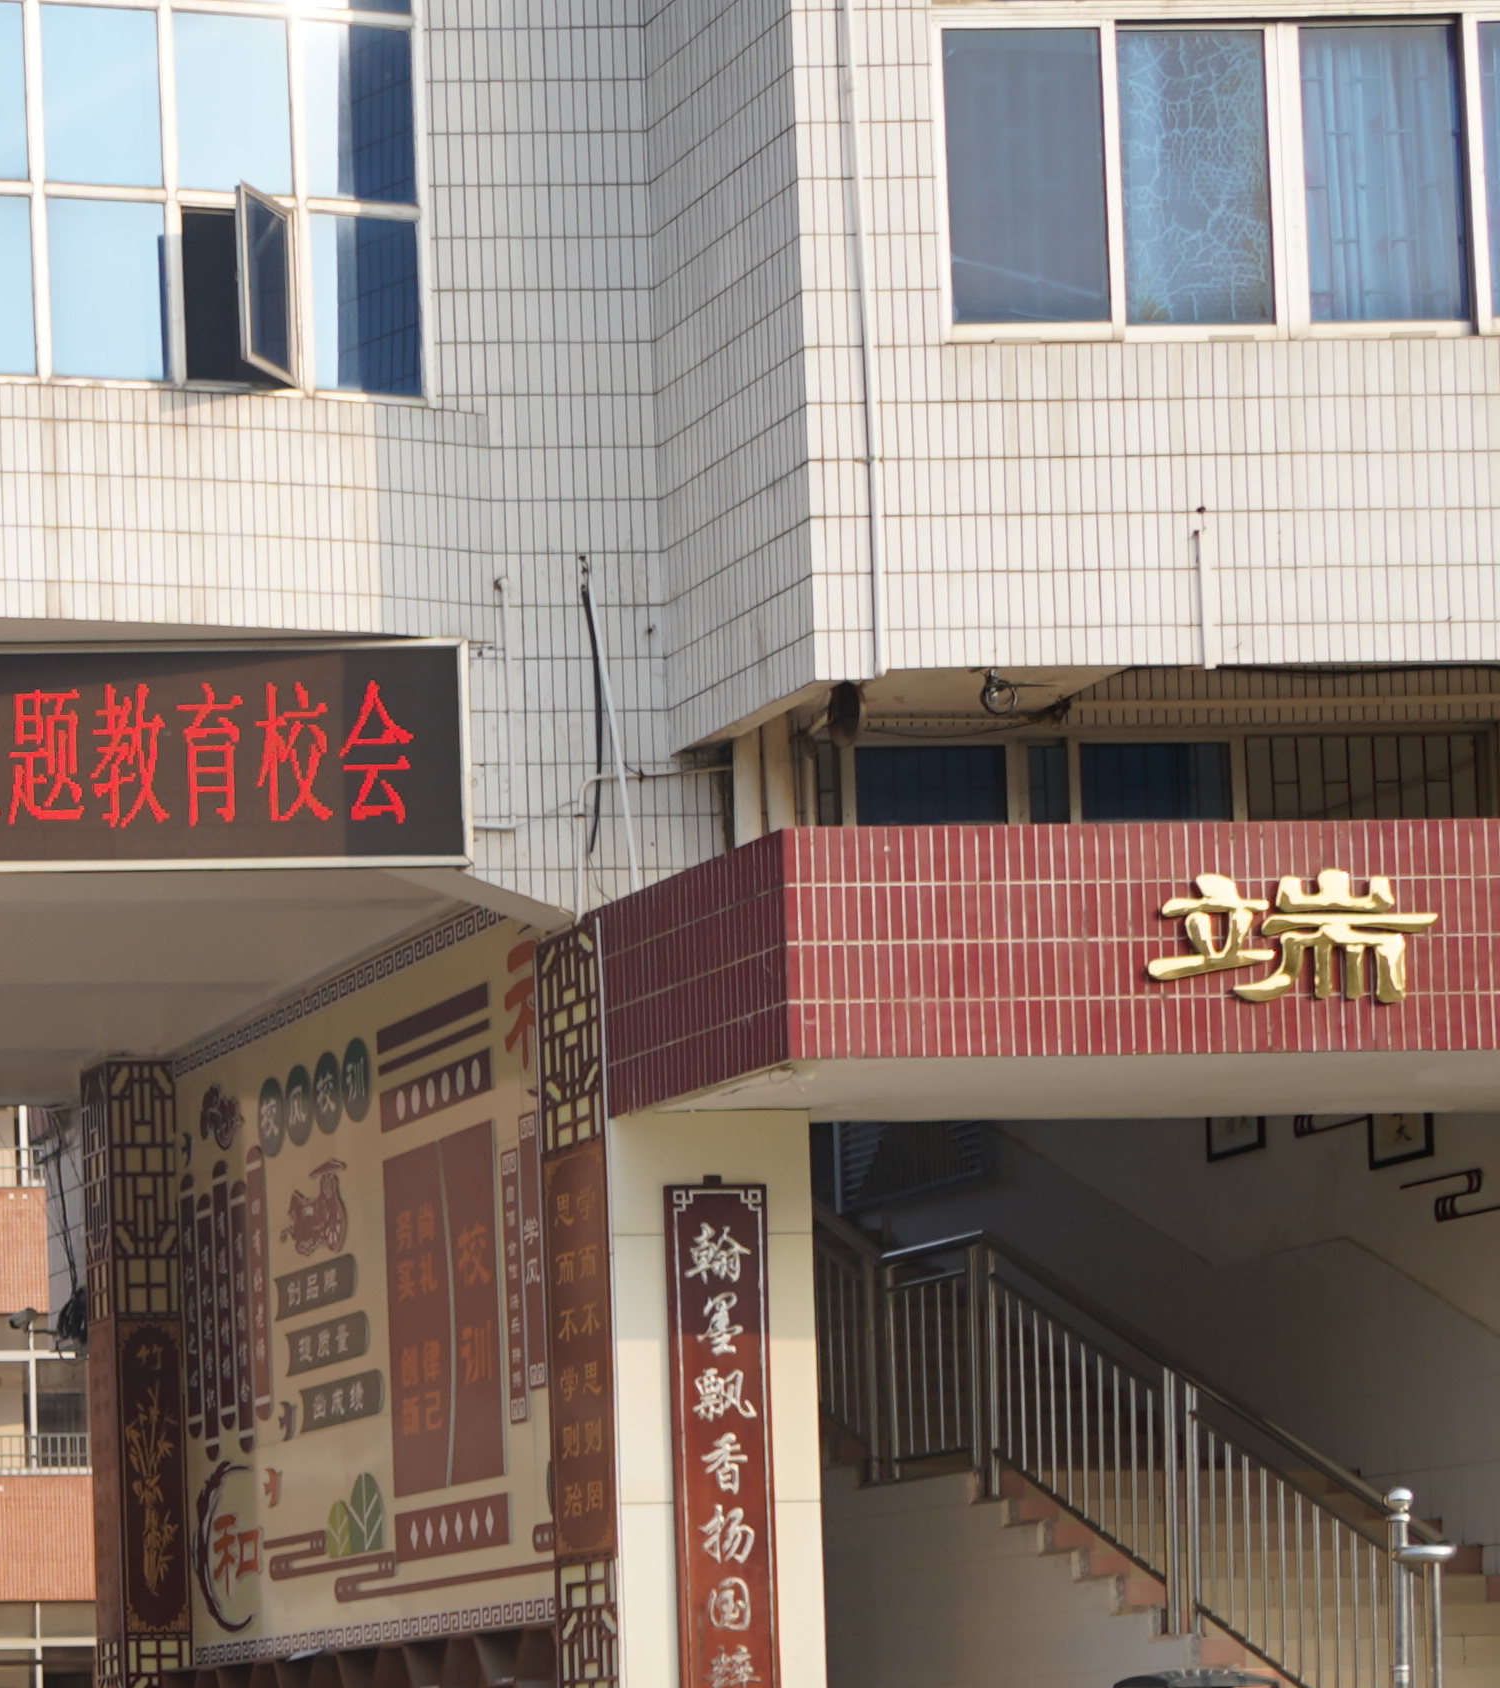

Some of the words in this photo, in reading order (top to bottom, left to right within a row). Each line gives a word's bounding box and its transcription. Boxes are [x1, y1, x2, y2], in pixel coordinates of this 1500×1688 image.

[260, 1055, 369, 1139] 校风校训
[457, 1220, 494, 1385] 校训
[522, 1217, 541, 1285] 学风
[554, 1193, 583, 1517] 思而不学则殆
[576, 1187, 604, 1512] 学而不思则罔
[212, 1513, 262, 1596] 和
